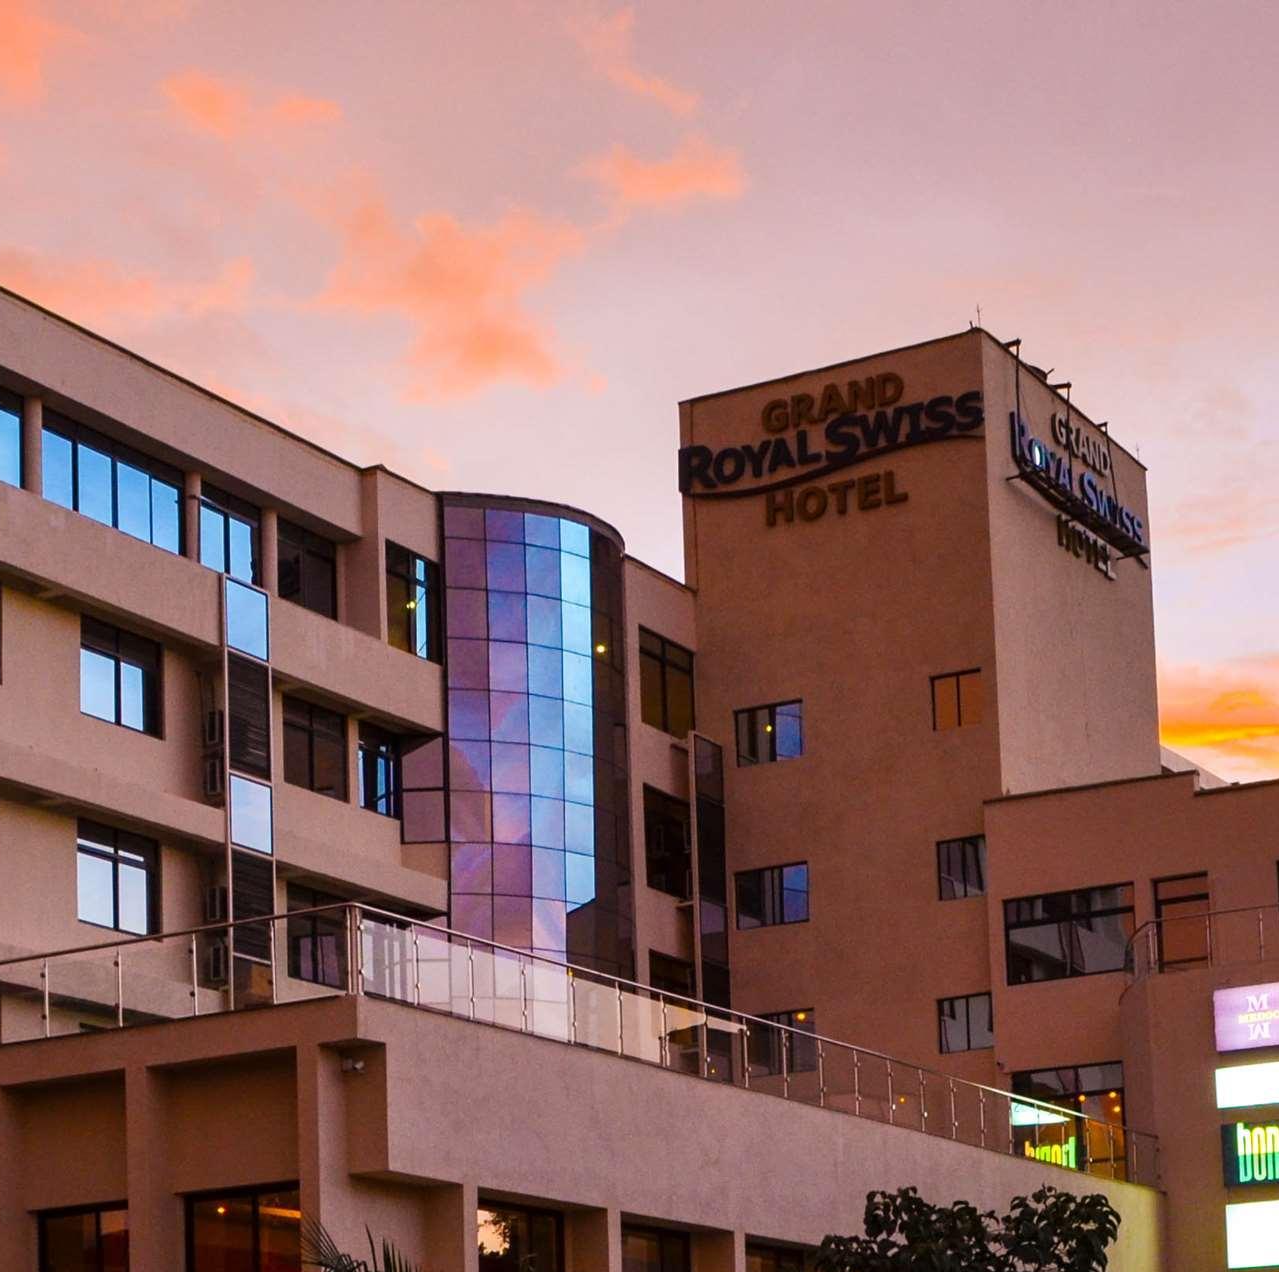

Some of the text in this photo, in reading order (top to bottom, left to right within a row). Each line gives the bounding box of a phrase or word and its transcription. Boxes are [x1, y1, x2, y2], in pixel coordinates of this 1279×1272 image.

[762, 372, 905, 434] GRAND
[678, 390, 986, 494] ROYAL SWISS
[1051, 411, 1110, 480] GRAND
[765, 470, 909, 527] HOTEL
[1247, 992, 1270, 1012] M
